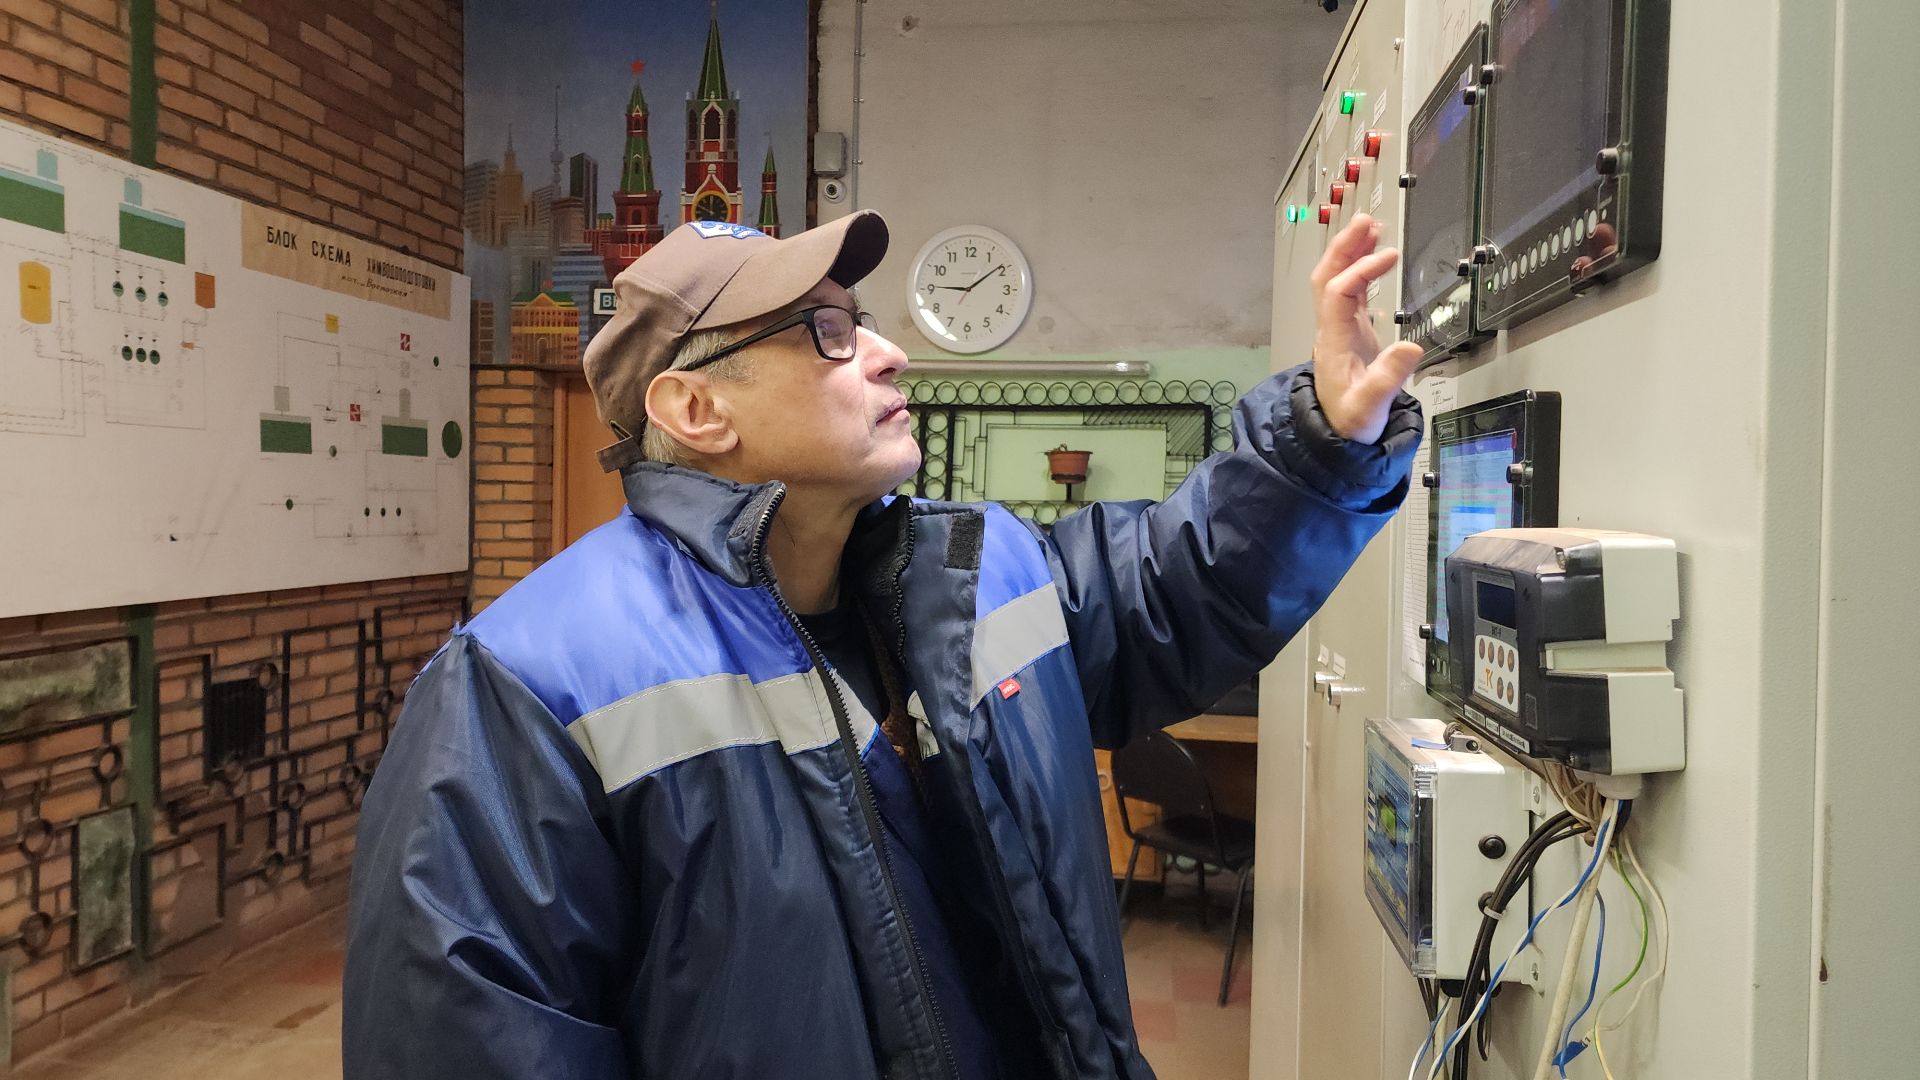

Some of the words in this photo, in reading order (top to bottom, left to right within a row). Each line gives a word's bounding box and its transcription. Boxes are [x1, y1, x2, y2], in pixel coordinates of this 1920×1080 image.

[267, 226, 297, 250] БЛОК
[312, 240, 351, 267] СХЕМА
[965, 246, 977, 258] 12
[947, 252, 957, 263] 11
[934, 265, 946, 276] 10
[998, 265, 1006, 277] 2
[927, 284, 935, 294] 9
[1002, 285, 1011, 296] 3
[932, 302, 940, 314] 8
[995, 304, 1004, 314] 4
[946, 316, 955, 327] 7
[963, 321, 972, 333] 6
[982, 317, 991, 328] 5
